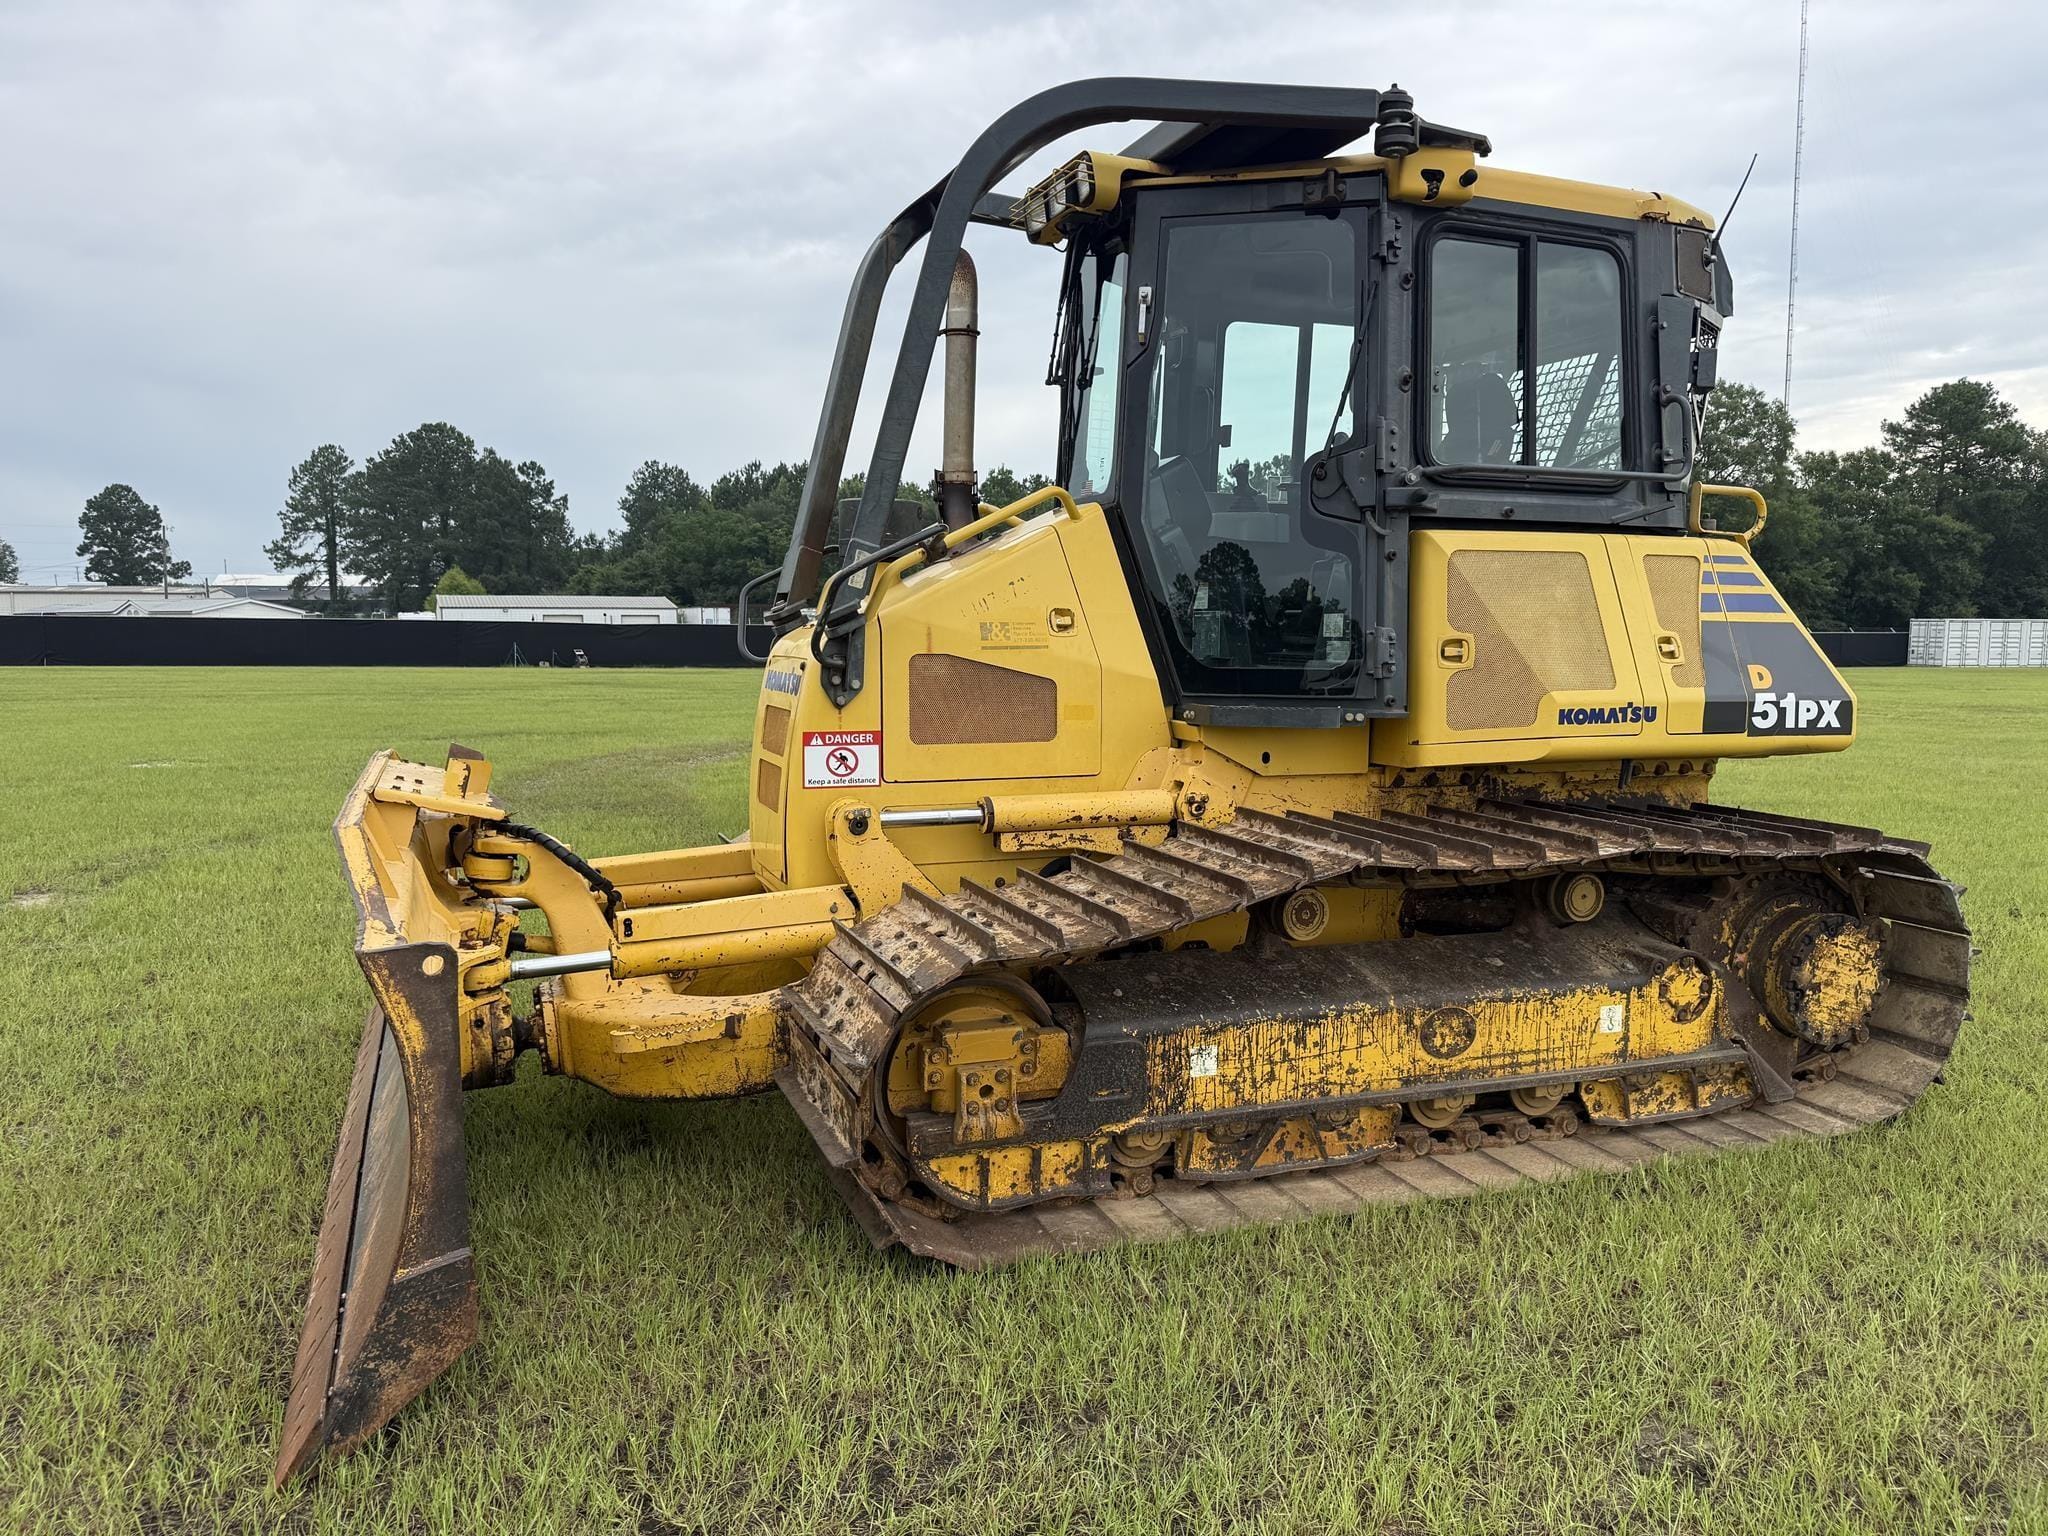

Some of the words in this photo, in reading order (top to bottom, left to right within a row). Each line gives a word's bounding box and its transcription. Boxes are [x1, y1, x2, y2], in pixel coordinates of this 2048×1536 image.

[765, 668, 802, 696] KOMATSU
[1746, 664, 1773, 690] D
[1558, 702, 1657, 725] KOMATSU
[1751, 692, 1842, 729] 51PX
[825, 733, 874, 744] DANGER
[808, 778, 826, 786] Keep
[833, 777, 847, 785] safe
[848, 776, 877, 784] distance
